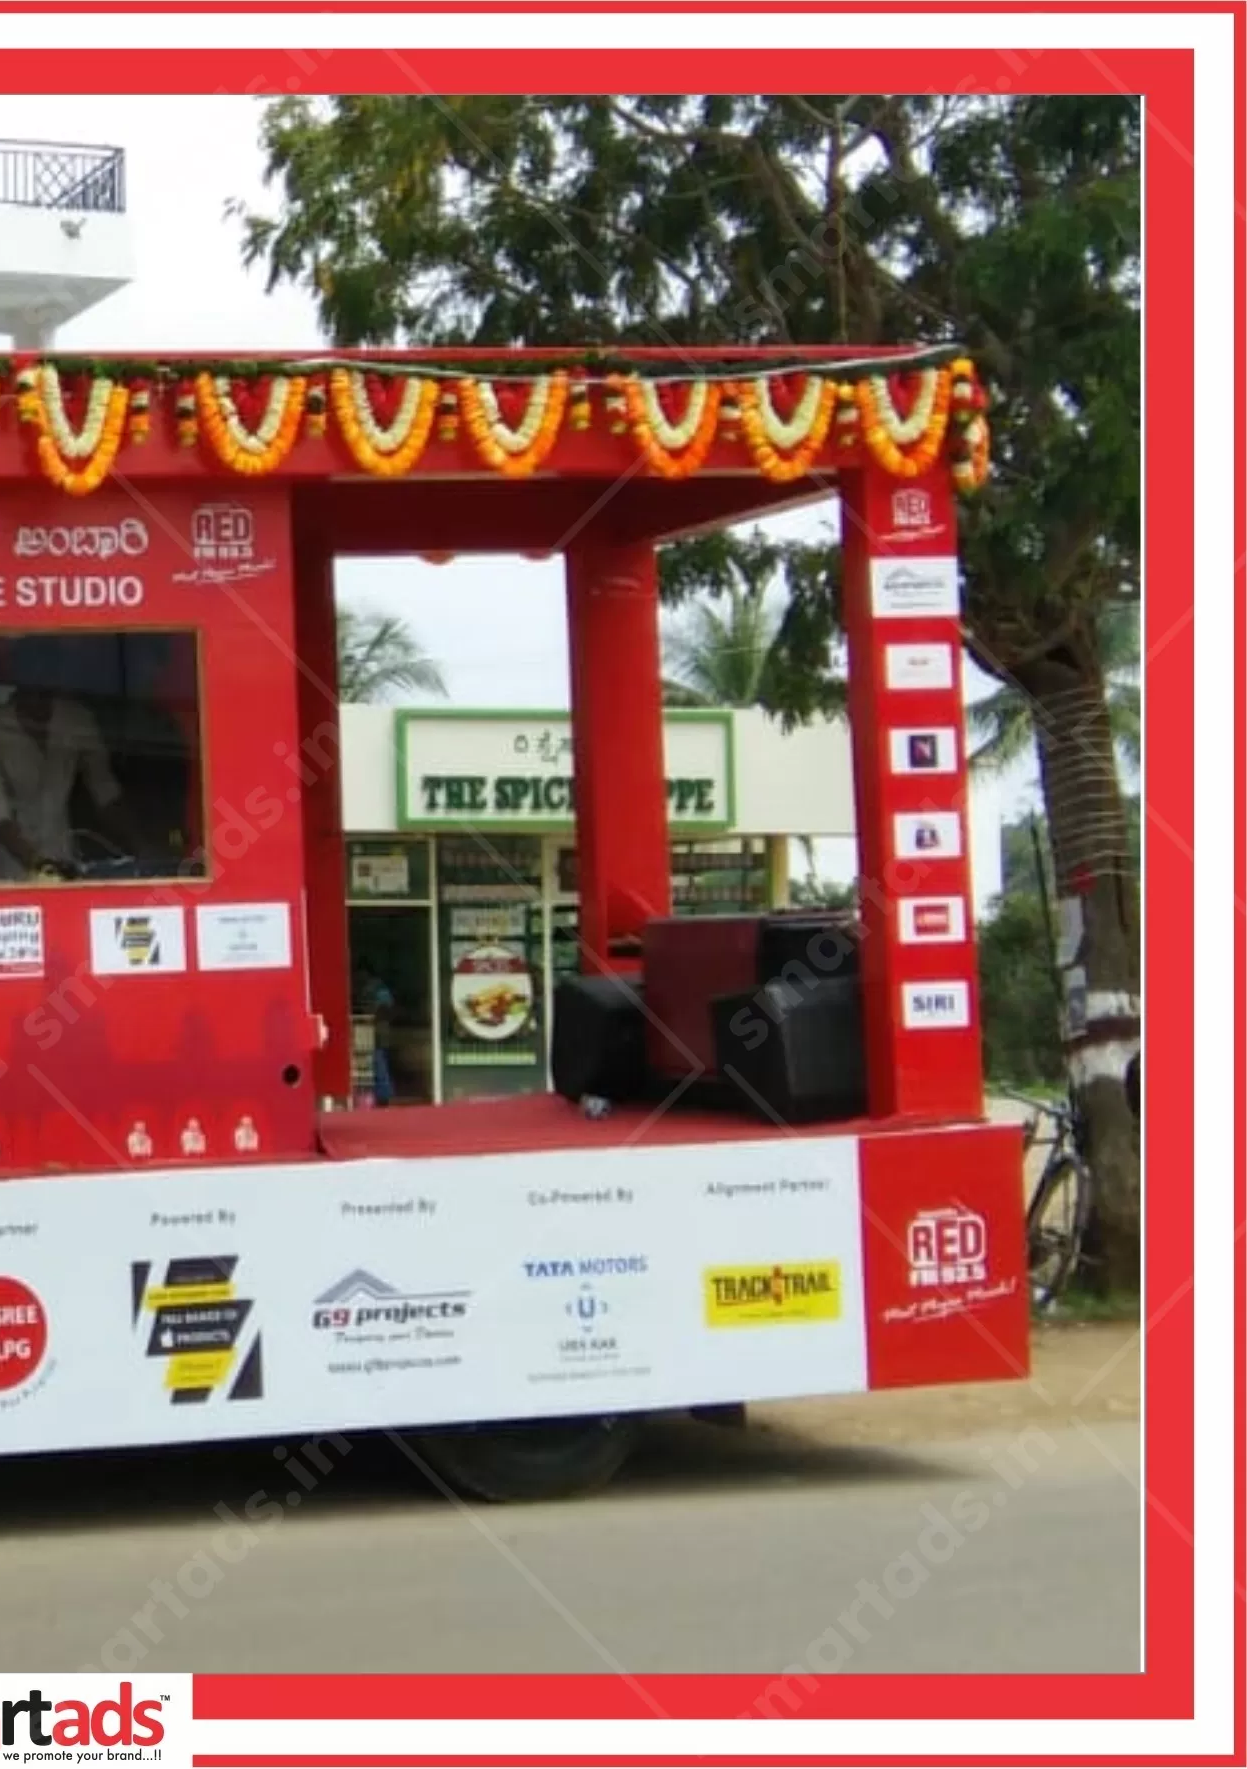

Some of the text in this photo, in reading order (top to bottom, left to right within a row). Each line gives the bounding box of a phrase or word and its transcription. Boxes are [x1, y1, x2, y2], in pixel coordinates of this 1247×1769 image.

[16, 576, 144, 607] STUDIO
[421, 775, 488, 812] THE
[912, 995, 955, 1011] SIRI
[706, 1180, 775, 1199] Alignment
[150, 1210, 213, 1226] Powered
[341, 1199, 413, 1217] Presented
[912, 1219, 983, 1263] RED
[524, 1255, 648, 1277] TATA MOTORS
[355, 1301, 466, 1327] projects
